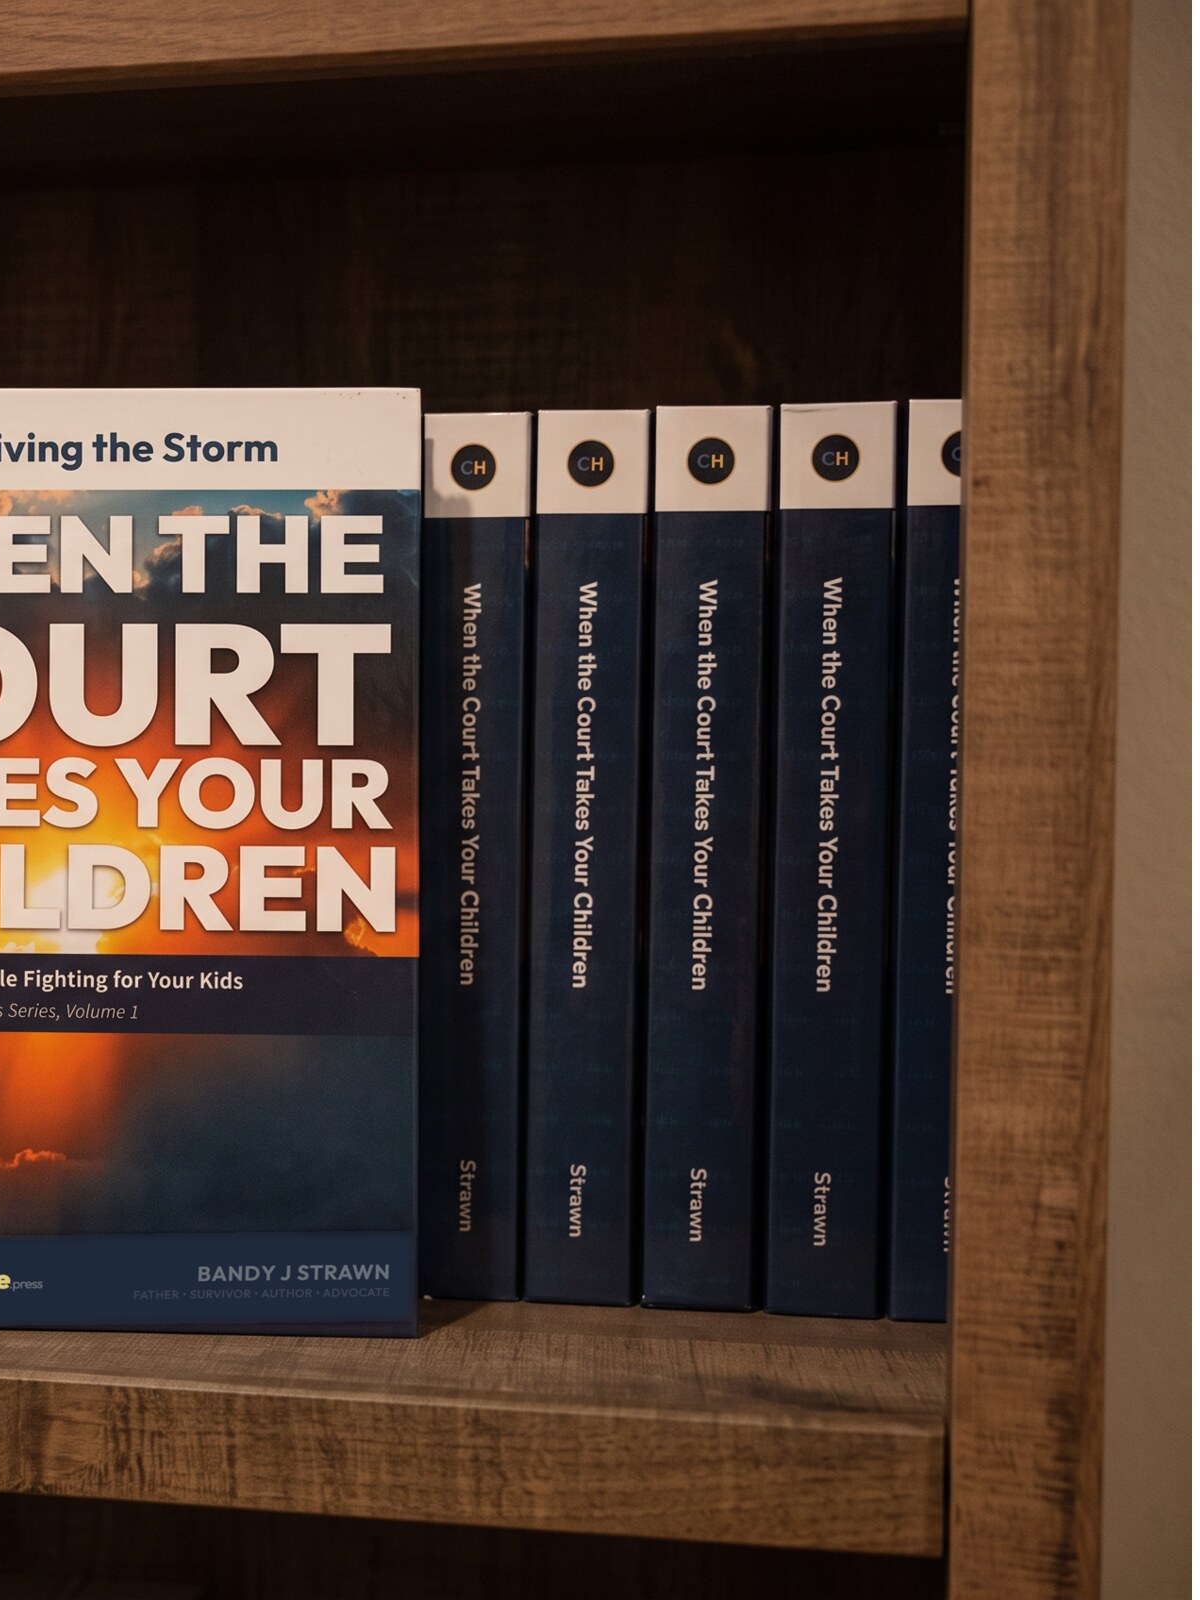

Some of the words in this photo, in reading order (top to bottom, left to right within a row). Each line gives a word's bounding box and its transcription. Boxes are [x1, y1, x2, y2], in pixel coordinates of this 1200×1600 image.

[92, 432, 154, 463] the
[162, 432, 279, 463] Storm
[460, 461, 486, 476] CH
[577, 456, 604, 472] CH
[697, 453, 724, 469] CH
[822, 451, 849, 466] CH
[157, 515, 385, 594] THE
[462, 582, 483, 649] When
[578, 581, 598, 647] When
[698, 579, 718, 646] When
[822, 576, 843, 645] When
[462, 653, 483, 691] the
[577, 652, 598, 691] the
[697, 651, 718, 690] the
[821, 650, 843, 689] the
[462, 696, 482, 761] Court
[576, 696, 597, 761] Court
[695, 695, 717, 761] Court
[820, 694, 842, 761] Court
[115, 757, 394, 830] YOUR
[461, 765, 481, 830] Takes
[575, 765, 595, 831] Takes
[694, 765, 715, 831] Takes
[819, 765, 840, 832] Takes
[461, 834, 480, 885] Your
[574, 835, 594, 887] Your
[693, 836, 714, 888] Your
[818, 836, 839, 889] Your
[460, 890, 480, 985] Children
[572, 892, 594, 989] Children
[691, 893, 713, 991] Children
[816, 894, 838, 993] Children
[8, 1003, 60, 1021] Series,
[66, 1003, 126, 1019] Volume
[129, 1005, 138, 1019] 1
[24, 970, 108, 992] Fighting
[113, 970, 143, 988] for
[148, 972, 194, 989] Your
[200, 972, 244, 990] Kids
[458, 1159, 477, 1232] Strawn
[568, 1164, 587, 1238] Strawn
[689, 1168, 708, 1242] Strawn
[813, 1171, 832, 1247] Strawn
[133, 1290, 180, 1300] FATHER
[189, 1289, 251, 1299] SURVIVOR
[261, 1288, 313, 1299] AUTHOR
[323, 1287, 390, 1298] ADVOCATE
[197, 1265, 276, 1282] BANDY
[280, 1265, 291, 1281] J
[297, 1264, 390, 1281] STRAWN
